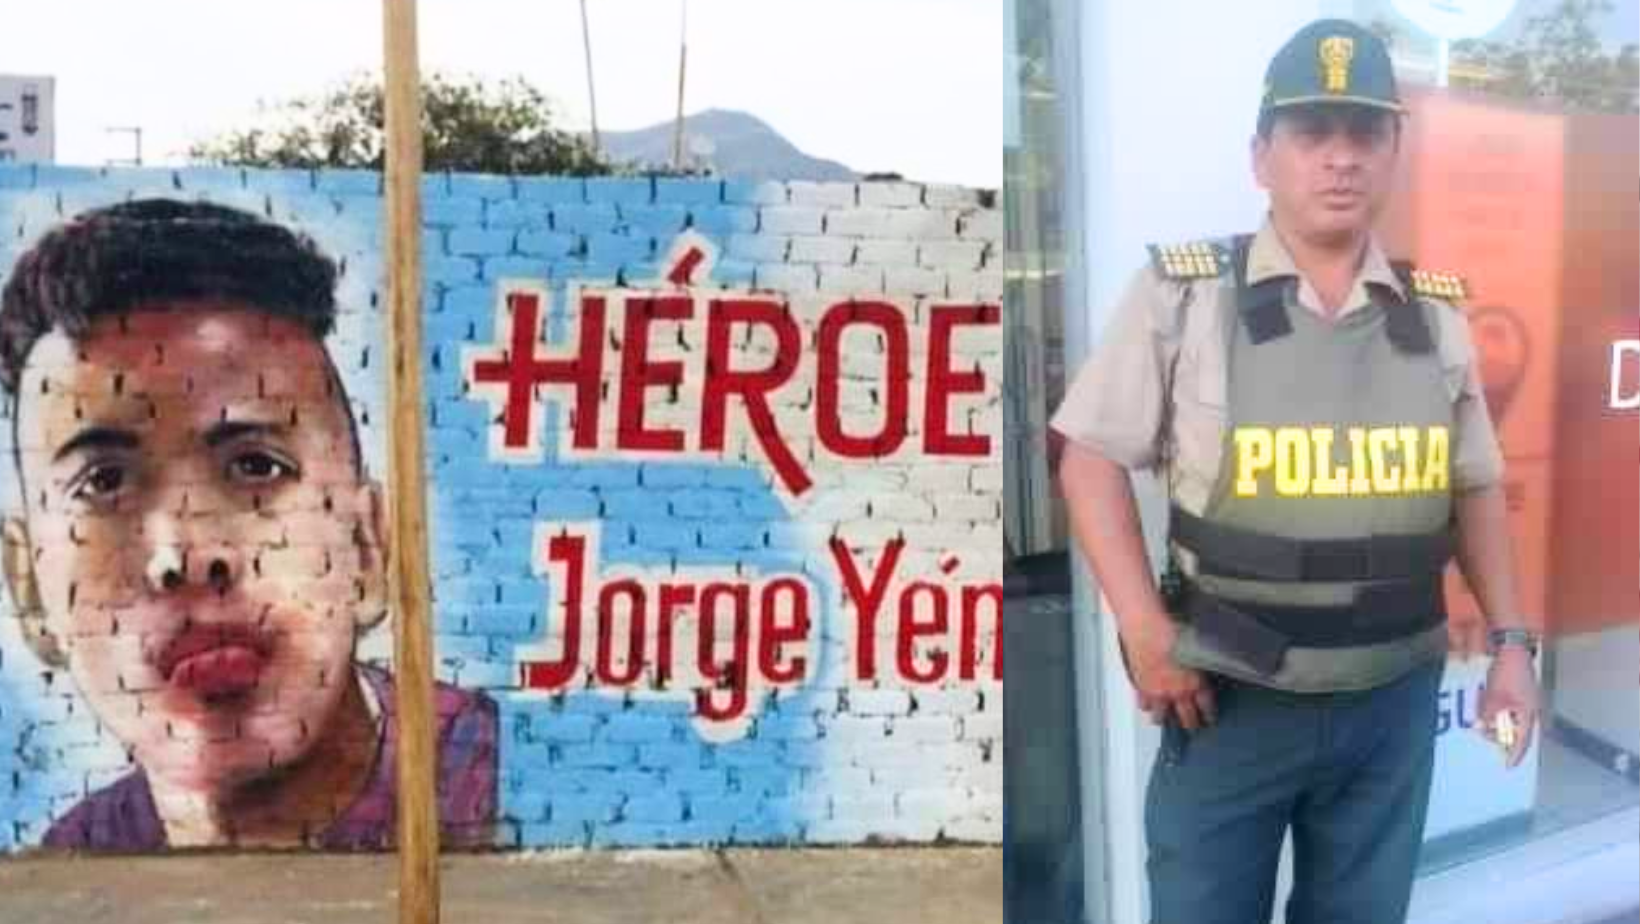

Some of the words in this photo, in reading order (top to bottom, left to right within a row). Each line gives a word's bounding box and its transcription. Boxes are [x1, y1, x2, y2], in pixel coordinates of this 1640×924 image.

[474, 246, 1000, 495] HÉROE
[1234, 425, 1449, 496] POLICIA
[522, 534, 810, 722] Jorge
